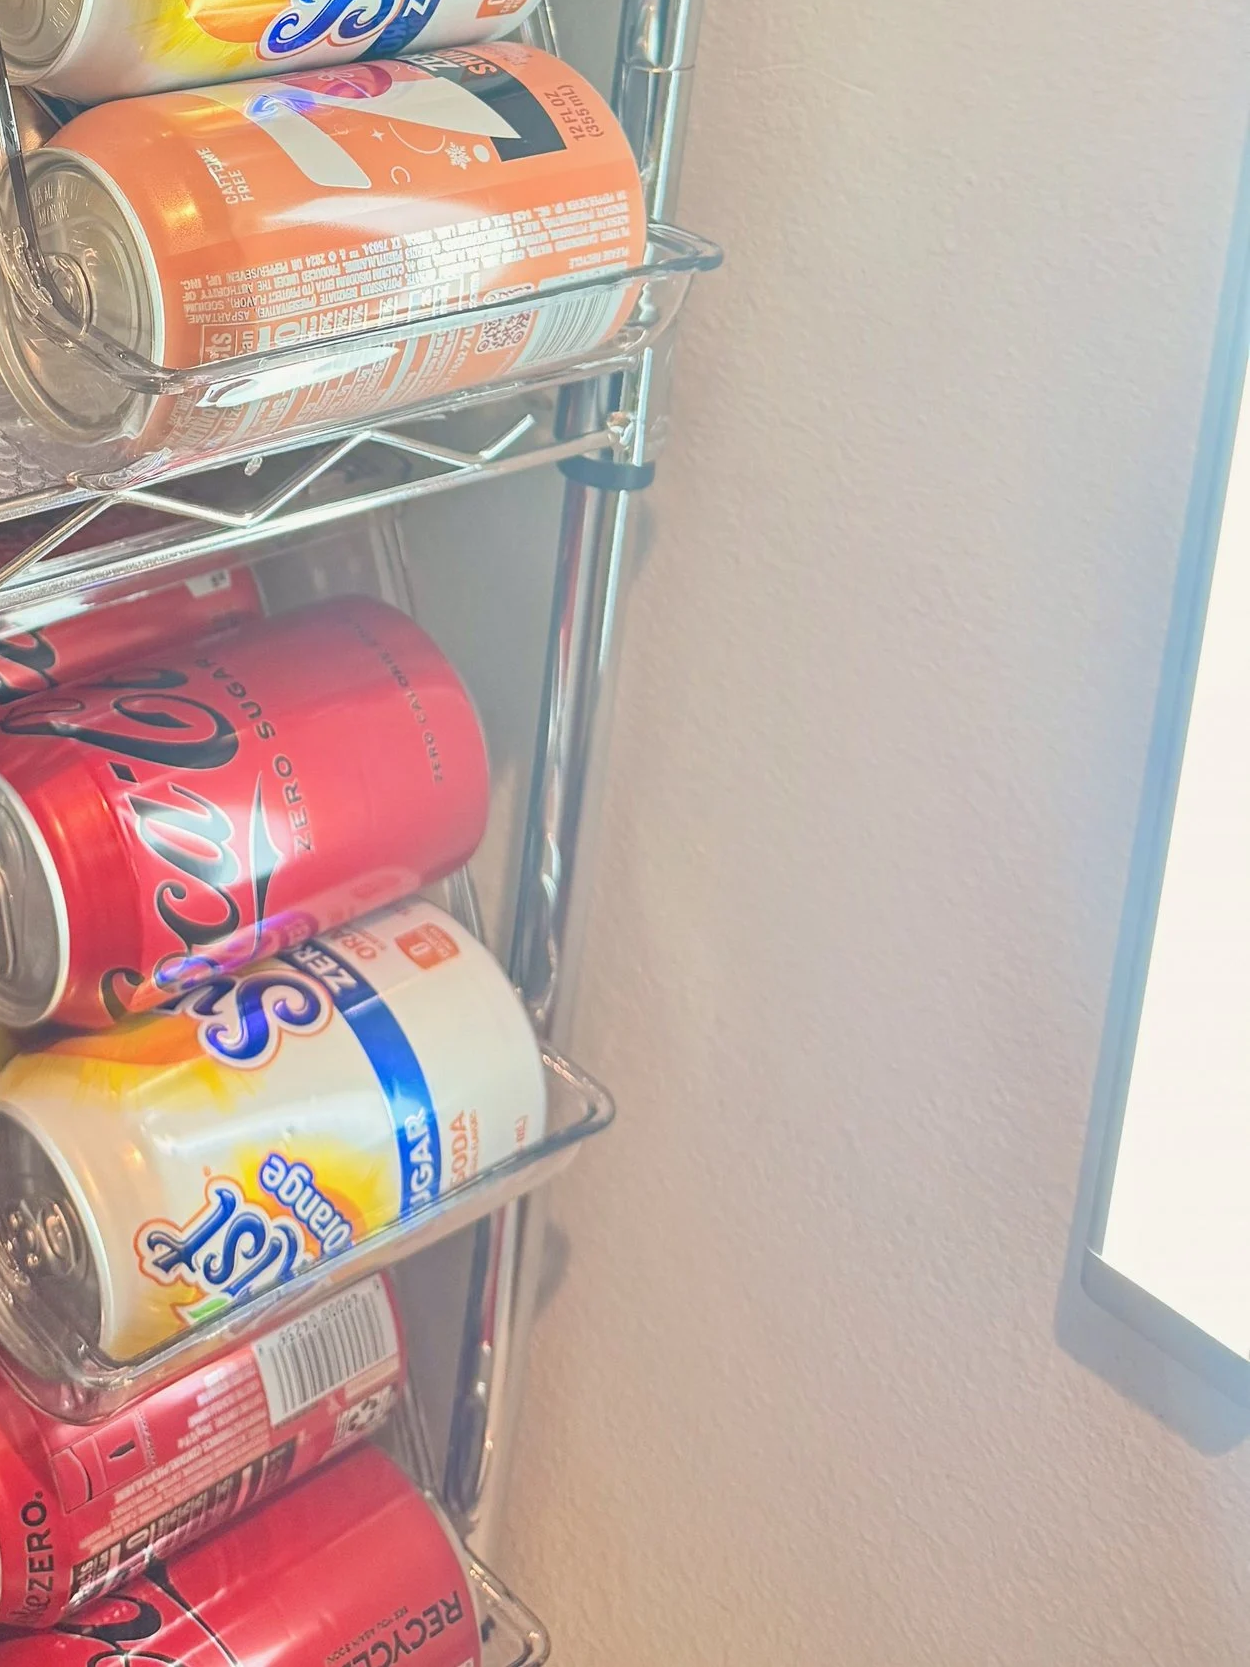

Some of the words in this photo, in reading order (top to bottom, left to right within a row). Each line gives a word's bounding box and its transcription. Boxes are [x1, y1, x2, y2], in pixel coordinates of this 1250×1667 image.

[544, 89, 563, 106] OZ
[559, 83, 582, 106] mL)
[560, 108, 578, 124] FL
[576, 109, 603, 136] (355
[569, 126, 586, 139] 12
[228, 169, 254, 201] FREE
[179, 276, 201, 290] INC.
[224, 260, 288, 283] PEPPER/SEVEN
[180, 291, 196, 302] OF
[199, 280, 254, 302] AUTHORITY
[255, 278, 271, 292] THE
[196, 656, 276, 741] SUGAR
[280, 754, 314, 855] ZERO
[292, 942, 356, 994] ZER
[260, 1154, 352, 1252] Orange
